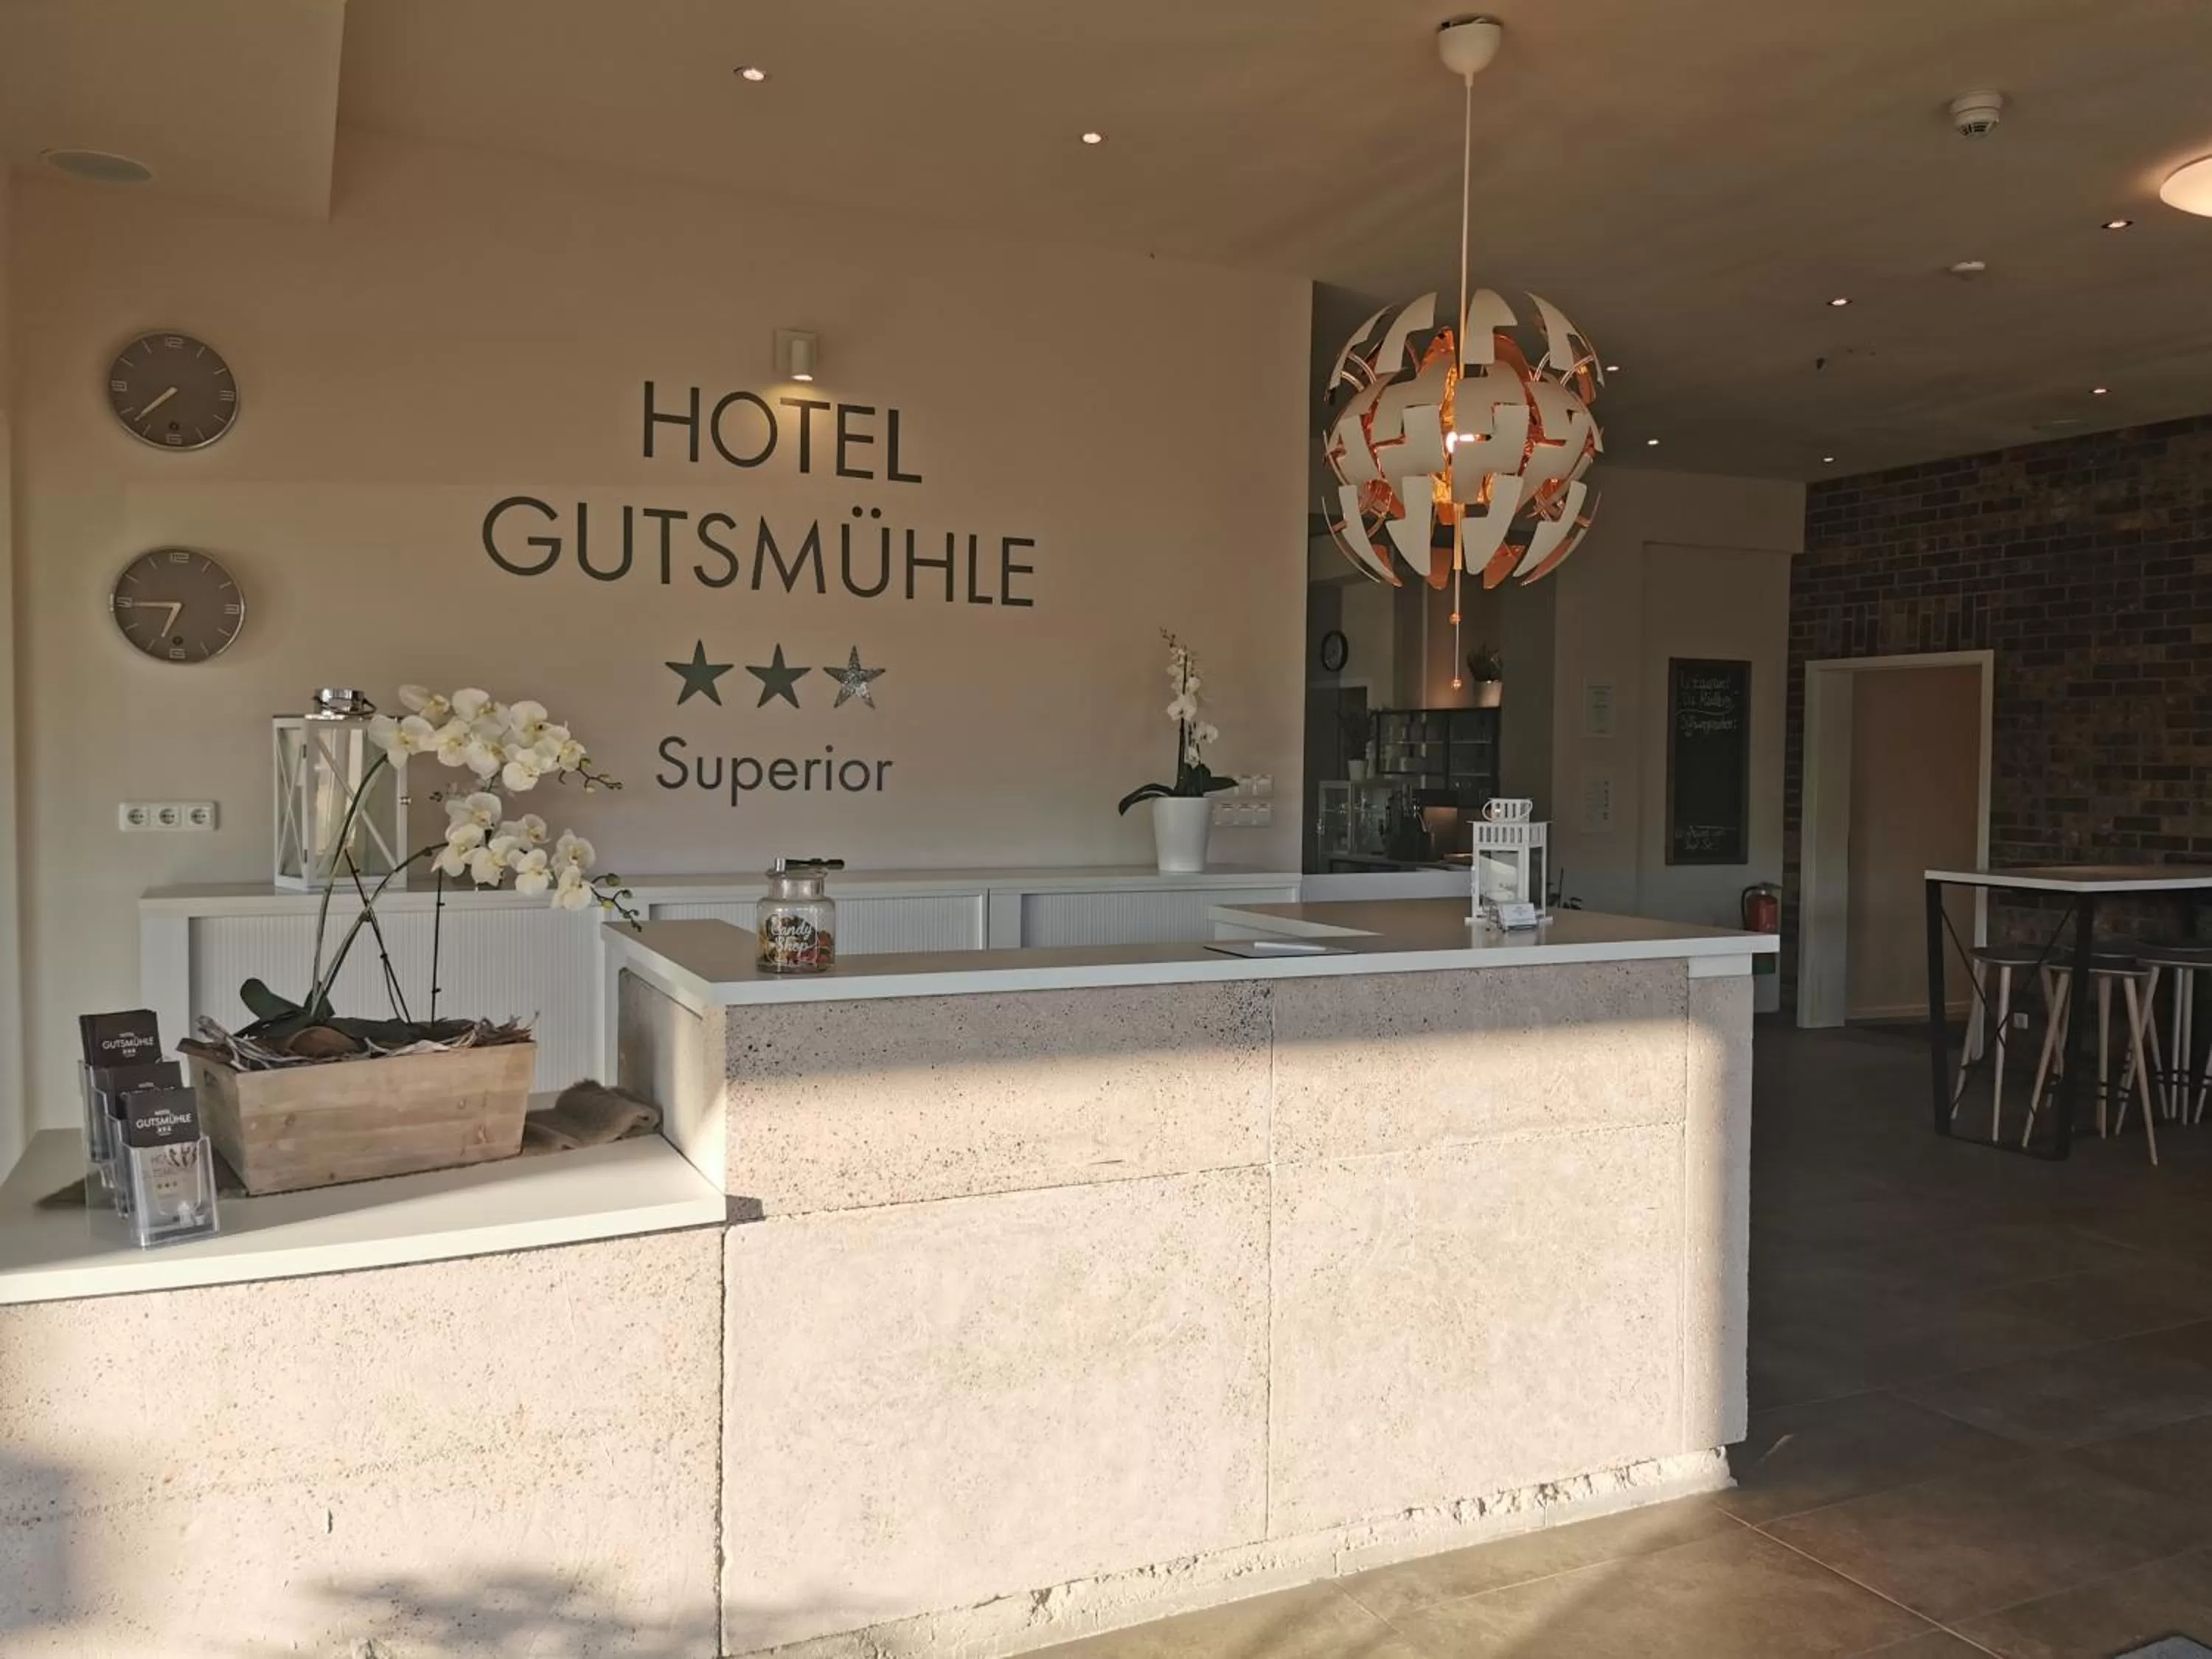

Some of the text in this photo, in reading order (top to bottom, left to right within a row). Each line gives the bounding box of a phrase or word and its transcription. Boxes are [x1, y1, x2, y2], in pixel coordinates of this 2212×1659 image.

[642, 380, 923, 484] HOTEL
[481, 495, 1036, 608] GUTSMÜHLE
[655, 736, 894, 807] Superior
[771, 914, 812, 939] Candy
[775, 936, 810, 957] Shop
